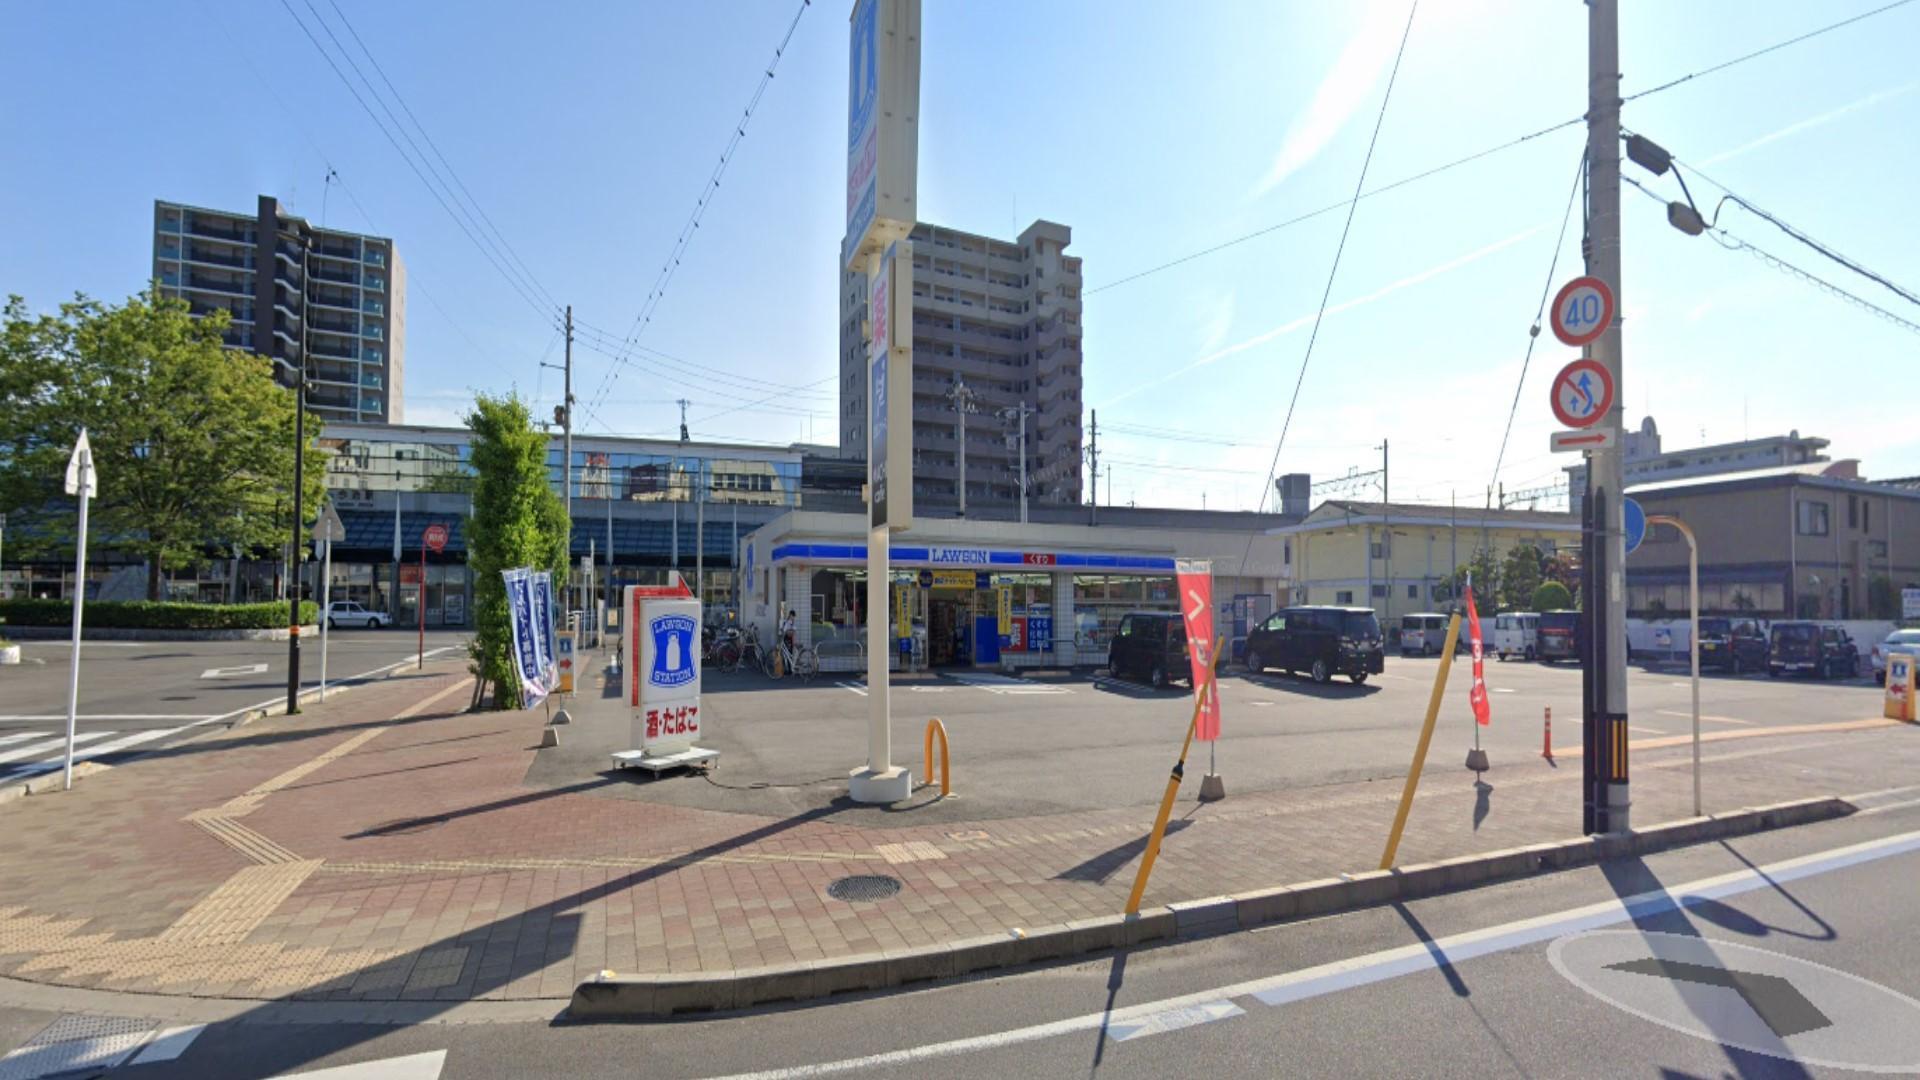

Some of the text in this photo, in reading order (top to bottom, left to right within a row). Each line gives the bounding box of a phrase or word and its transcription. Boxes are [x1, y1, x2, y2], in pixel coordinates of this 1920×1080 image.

[1565, 294, 1599, 327] 40
[931, 548, 987, 564] LAWSON
[654, 619, 694, 633] LAWSON
[654, 669, 692, 684] STATION
[646, 706, 698, 738] 酒・たばこ
